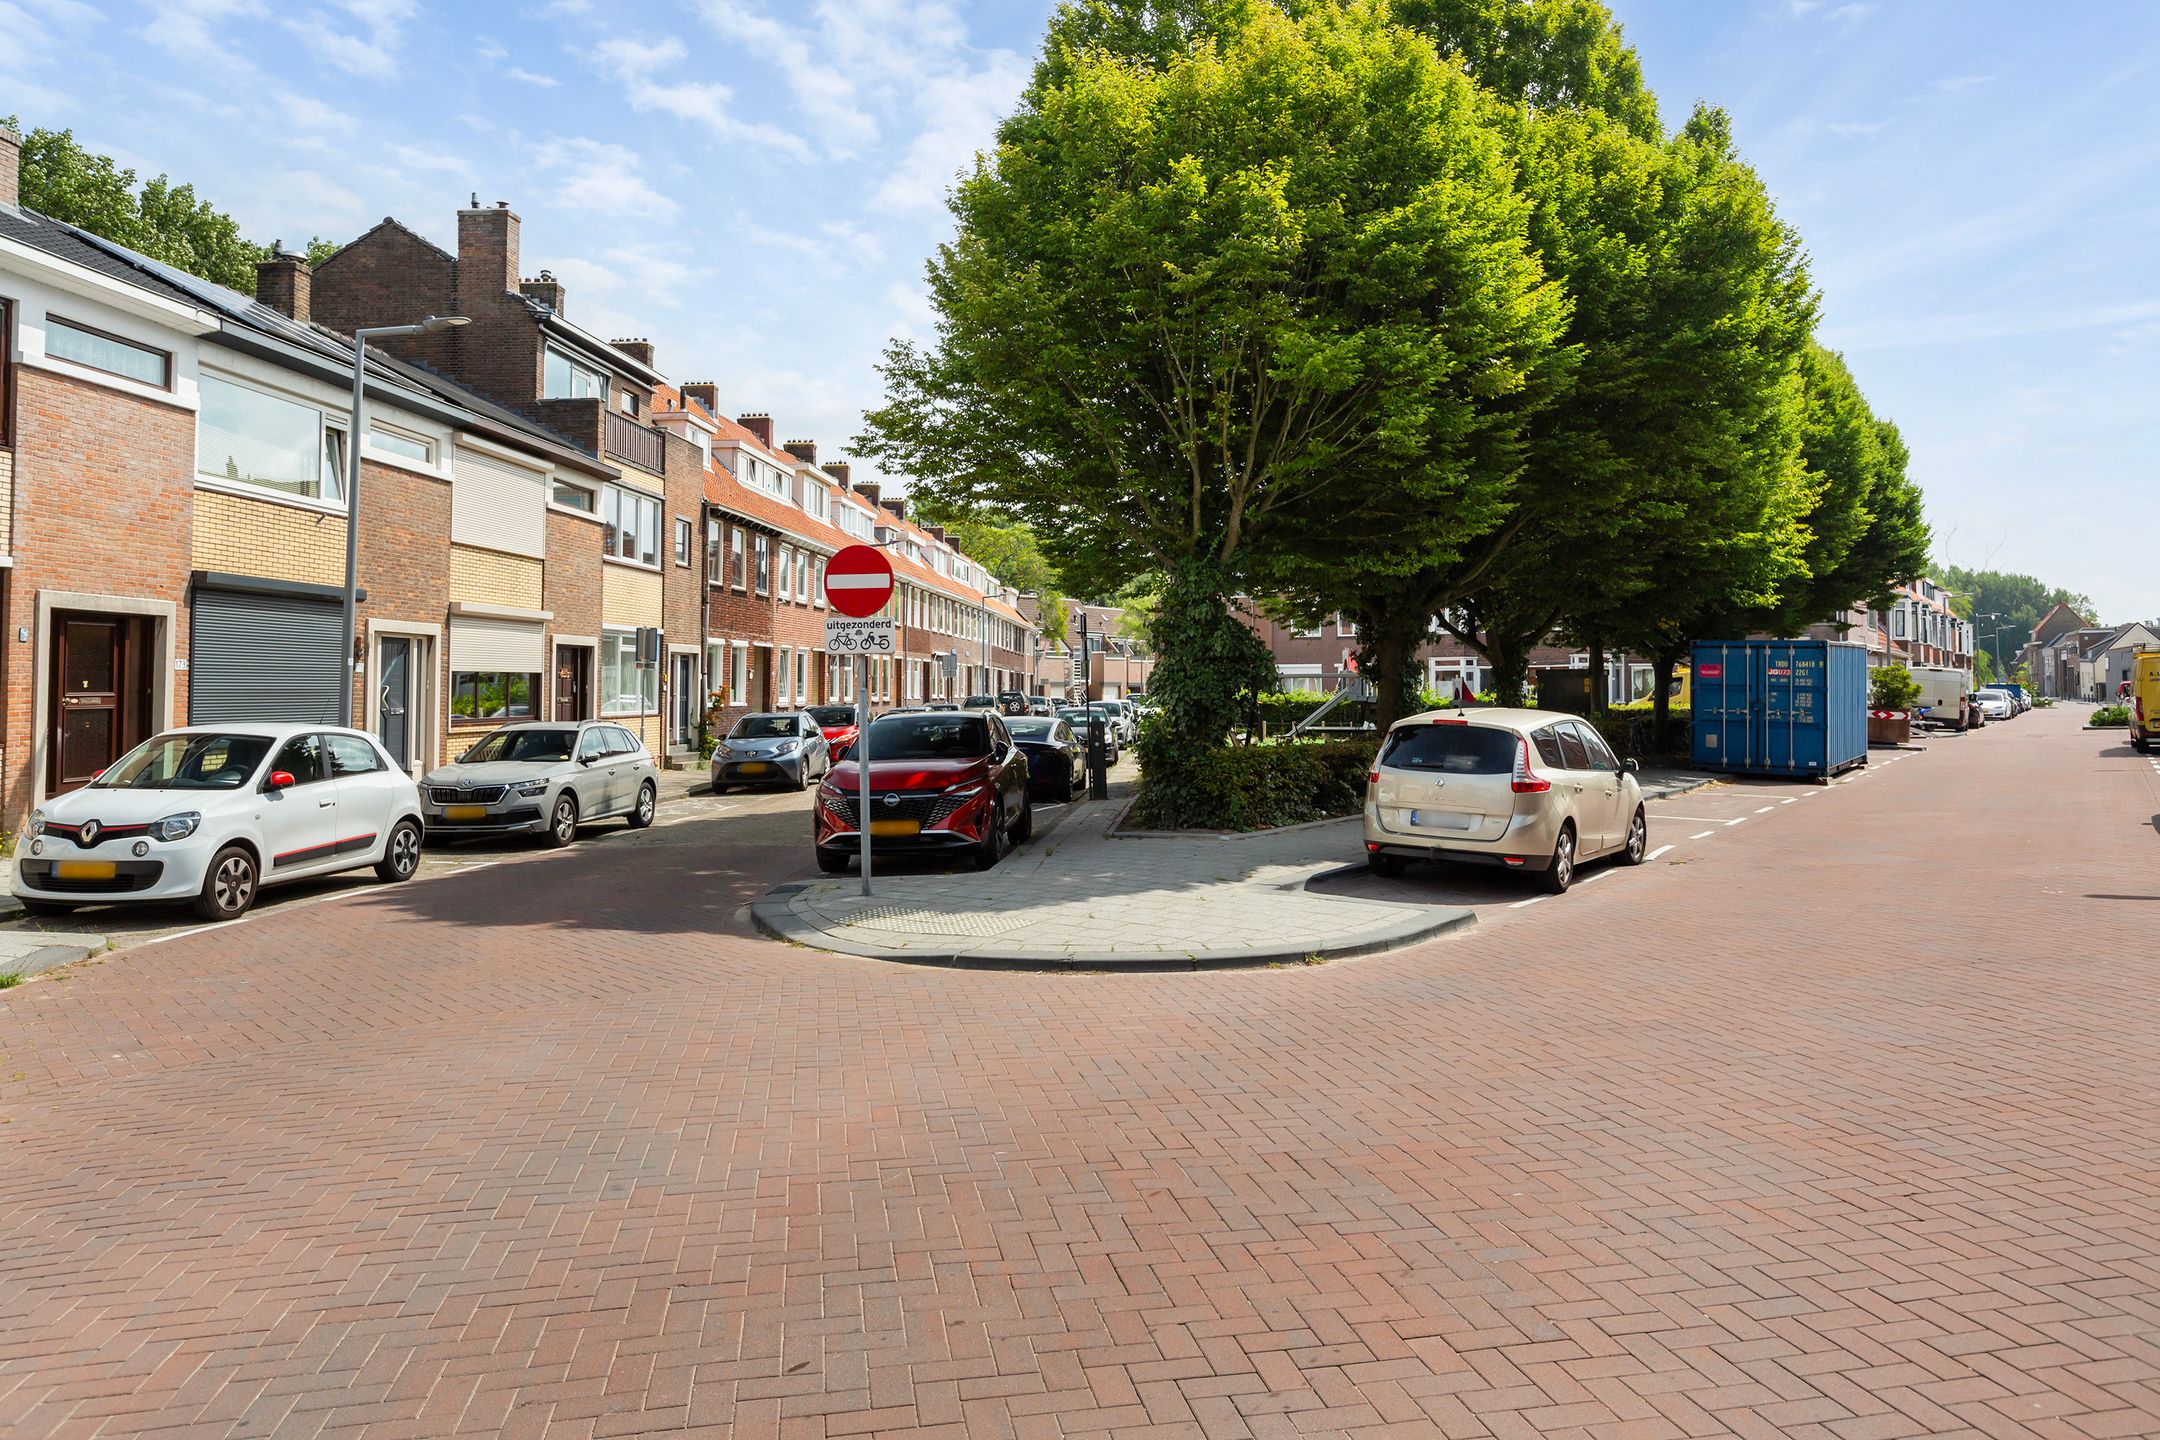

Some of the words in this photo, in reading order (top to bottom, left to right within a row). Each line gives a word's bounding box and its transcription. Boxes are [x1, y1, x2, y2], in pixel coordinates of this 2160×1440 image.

[827, 620, 892, 631] uitgezonderd
[175, 660, 186, 669] 173
[1768, 668, 1790, 676] JG073
